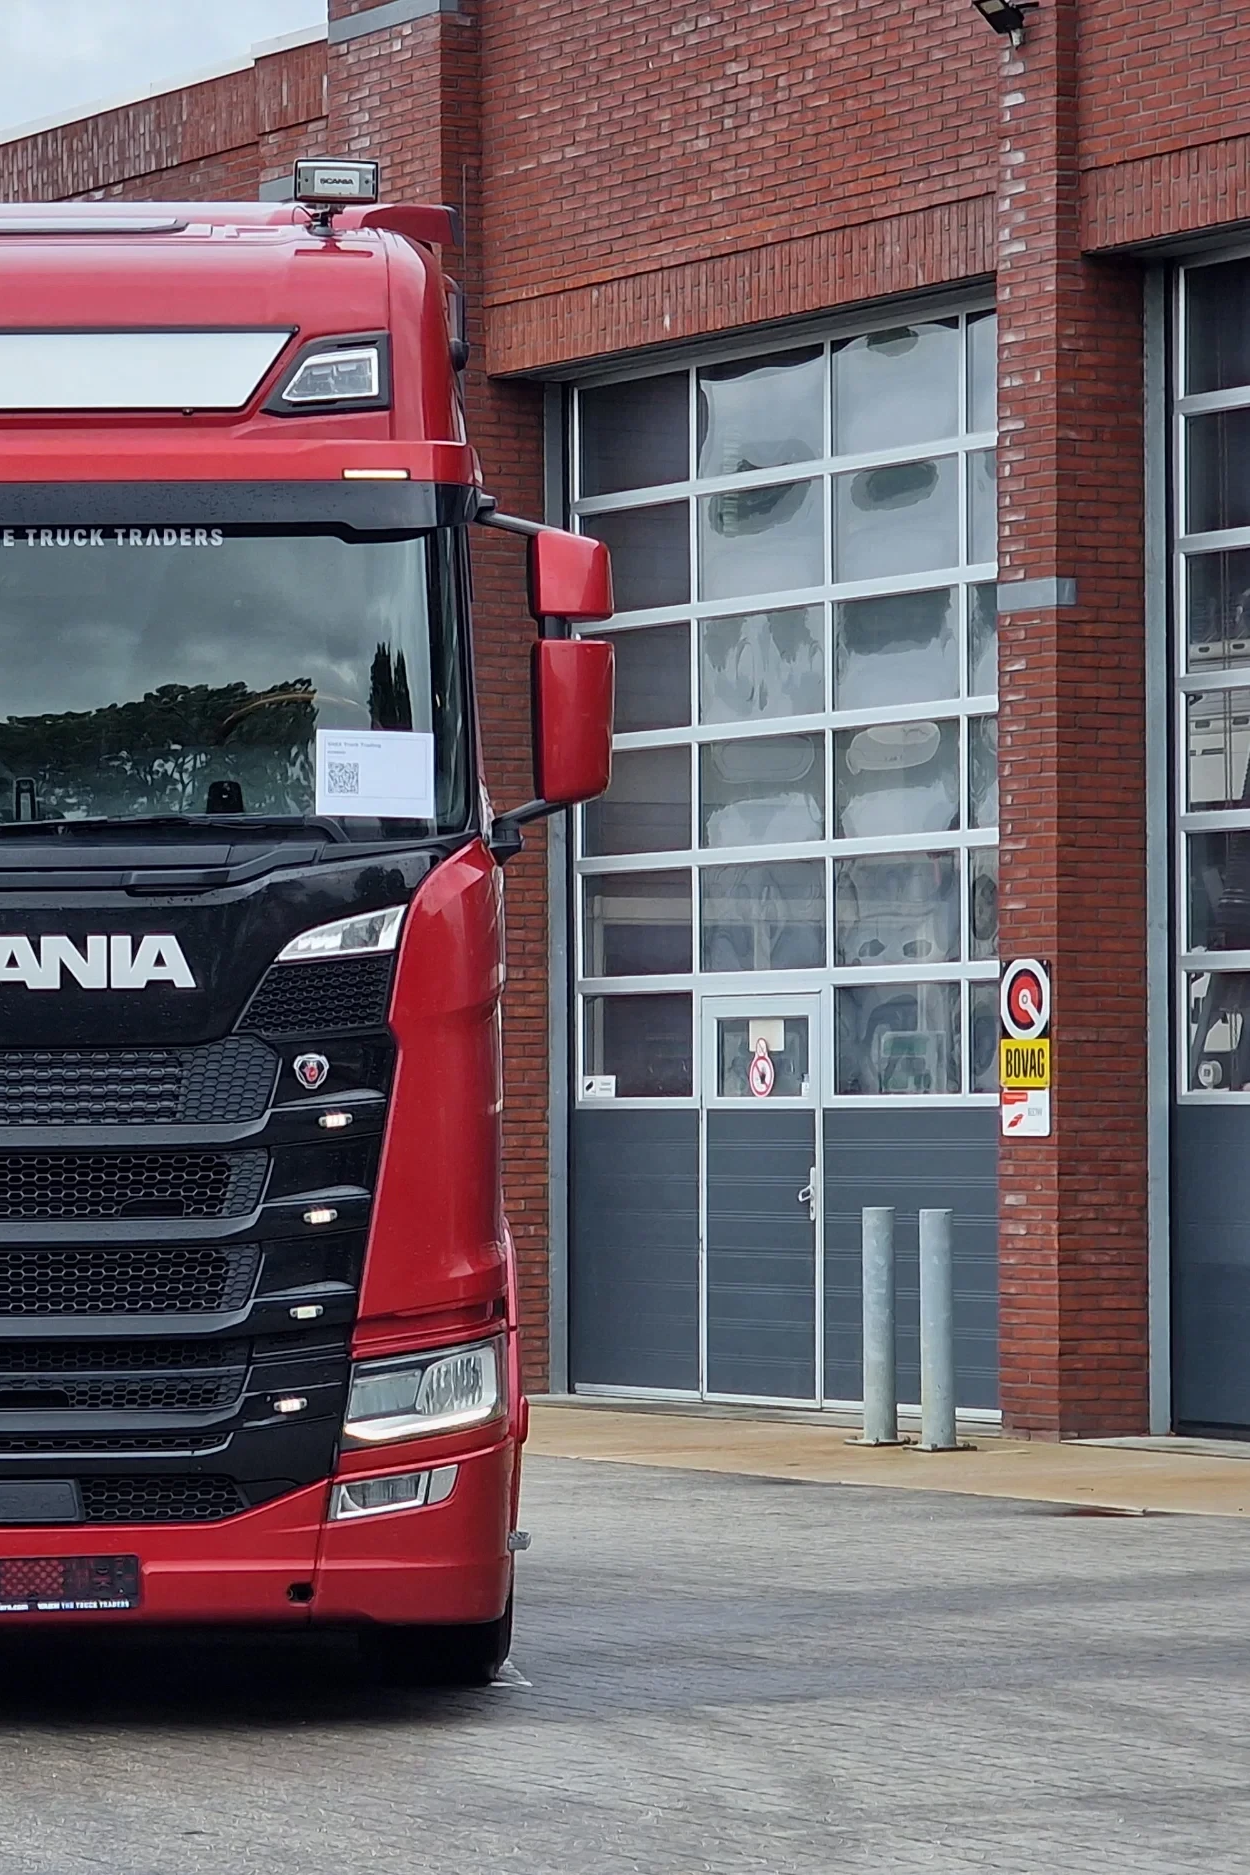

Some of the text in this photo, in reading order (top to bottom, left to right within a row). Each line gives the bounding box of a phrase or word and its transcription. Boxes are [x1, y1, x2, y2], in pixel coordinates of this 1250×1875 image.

[25, 528, 105, 547] TRUCK
[113, 527, 224, 547] TRADERS
[1005, 1048, 1045, 1079] BOVAG
